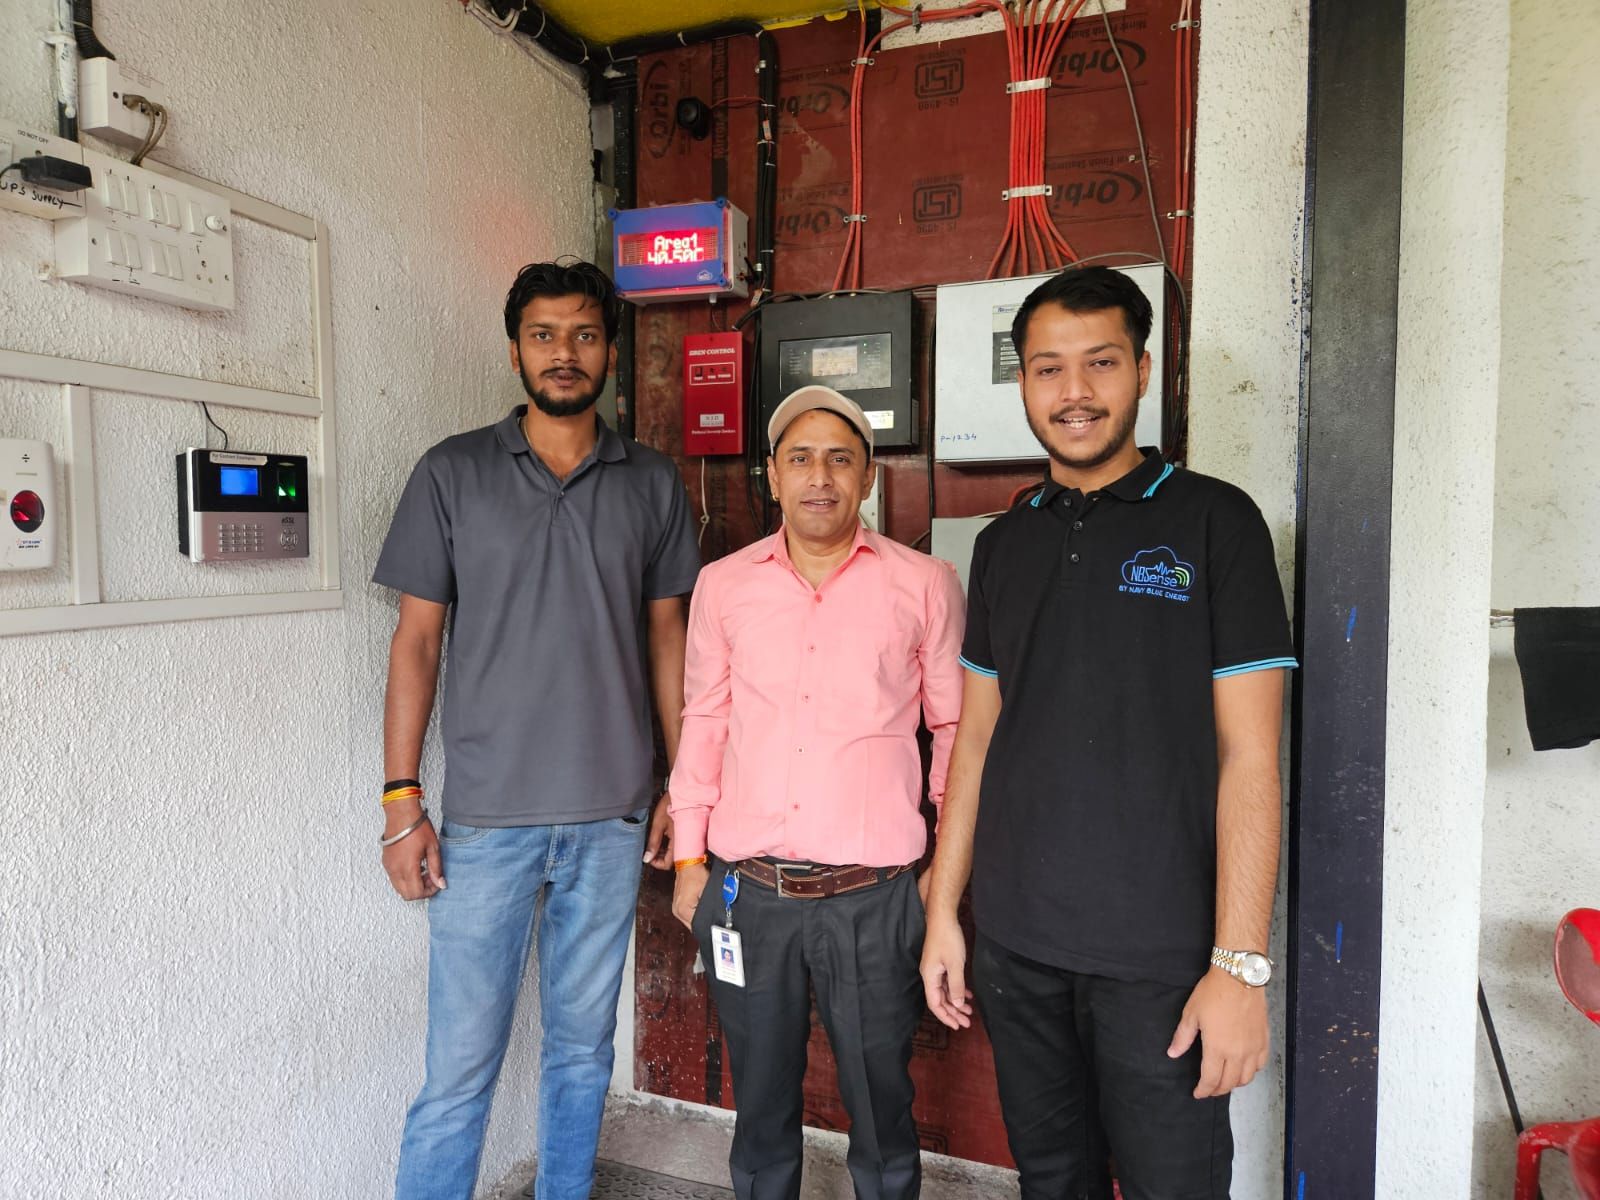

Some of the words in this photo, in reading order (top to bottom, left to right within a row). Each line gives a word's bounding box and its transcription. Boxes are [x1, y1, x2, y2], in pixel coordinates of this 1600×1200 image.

[26, 133, 38, 141] NOT
[38, 136, 49, 144] OFF
[0, 181, 26, 196] UPS
[1054, 179, 1119, 209] Orbi
[654, 232, 699, 251] Area1
[706, 347, 736, 355] CONTROL
[1146, 588, 1163, 597] BLUE
[1164, 592, 1190, 602] ENERGY
